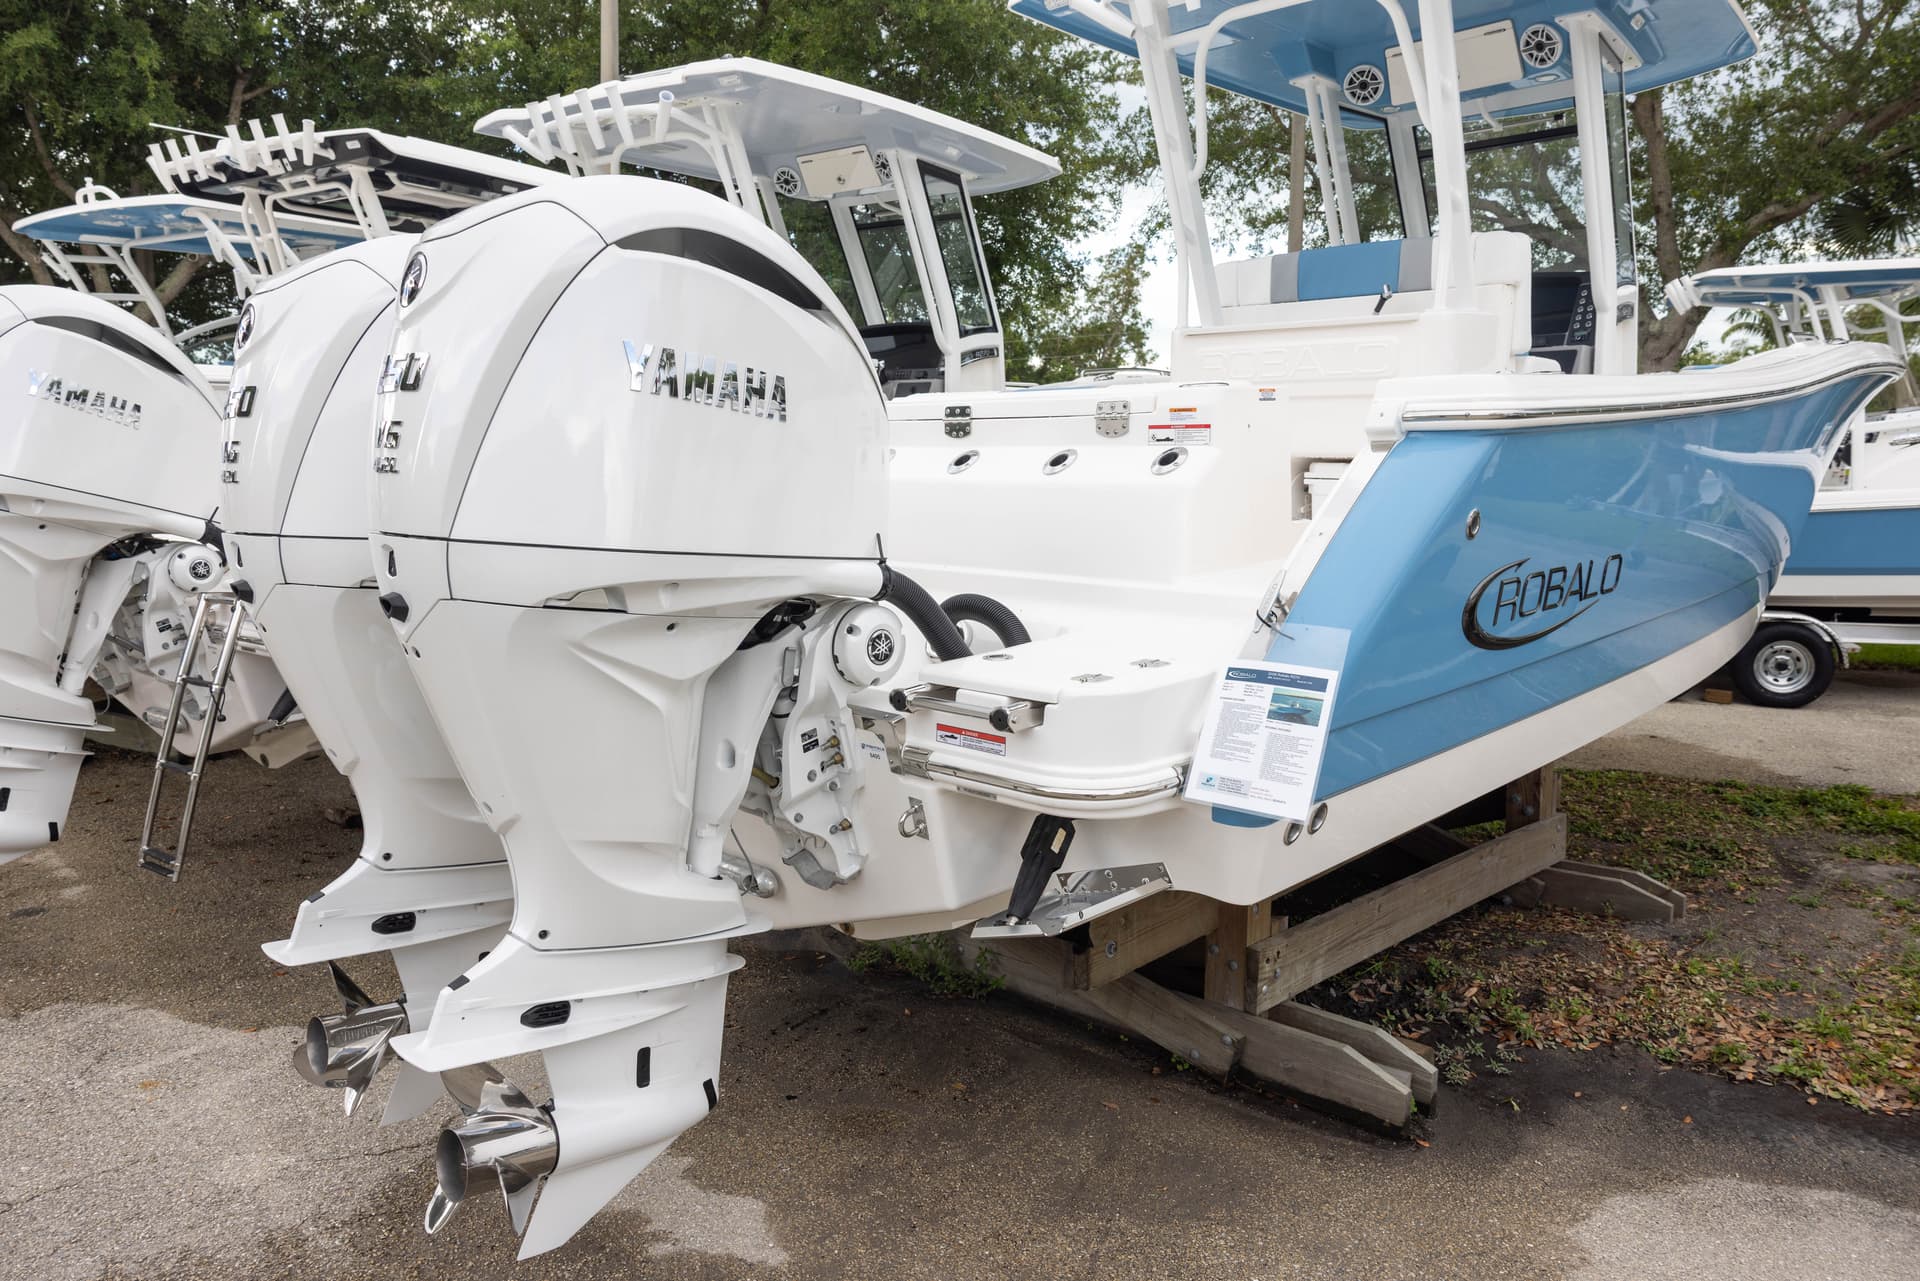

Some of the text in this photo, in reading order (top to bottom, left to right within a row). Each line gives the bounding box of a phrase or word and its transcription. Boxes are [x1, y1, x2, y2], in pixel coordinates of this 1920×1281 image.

[28, 366, 143, 431] YAMAHA
[623, 339, 788, 424] YAMAHA
[1492, 553, 1623, 626] ROBALO
